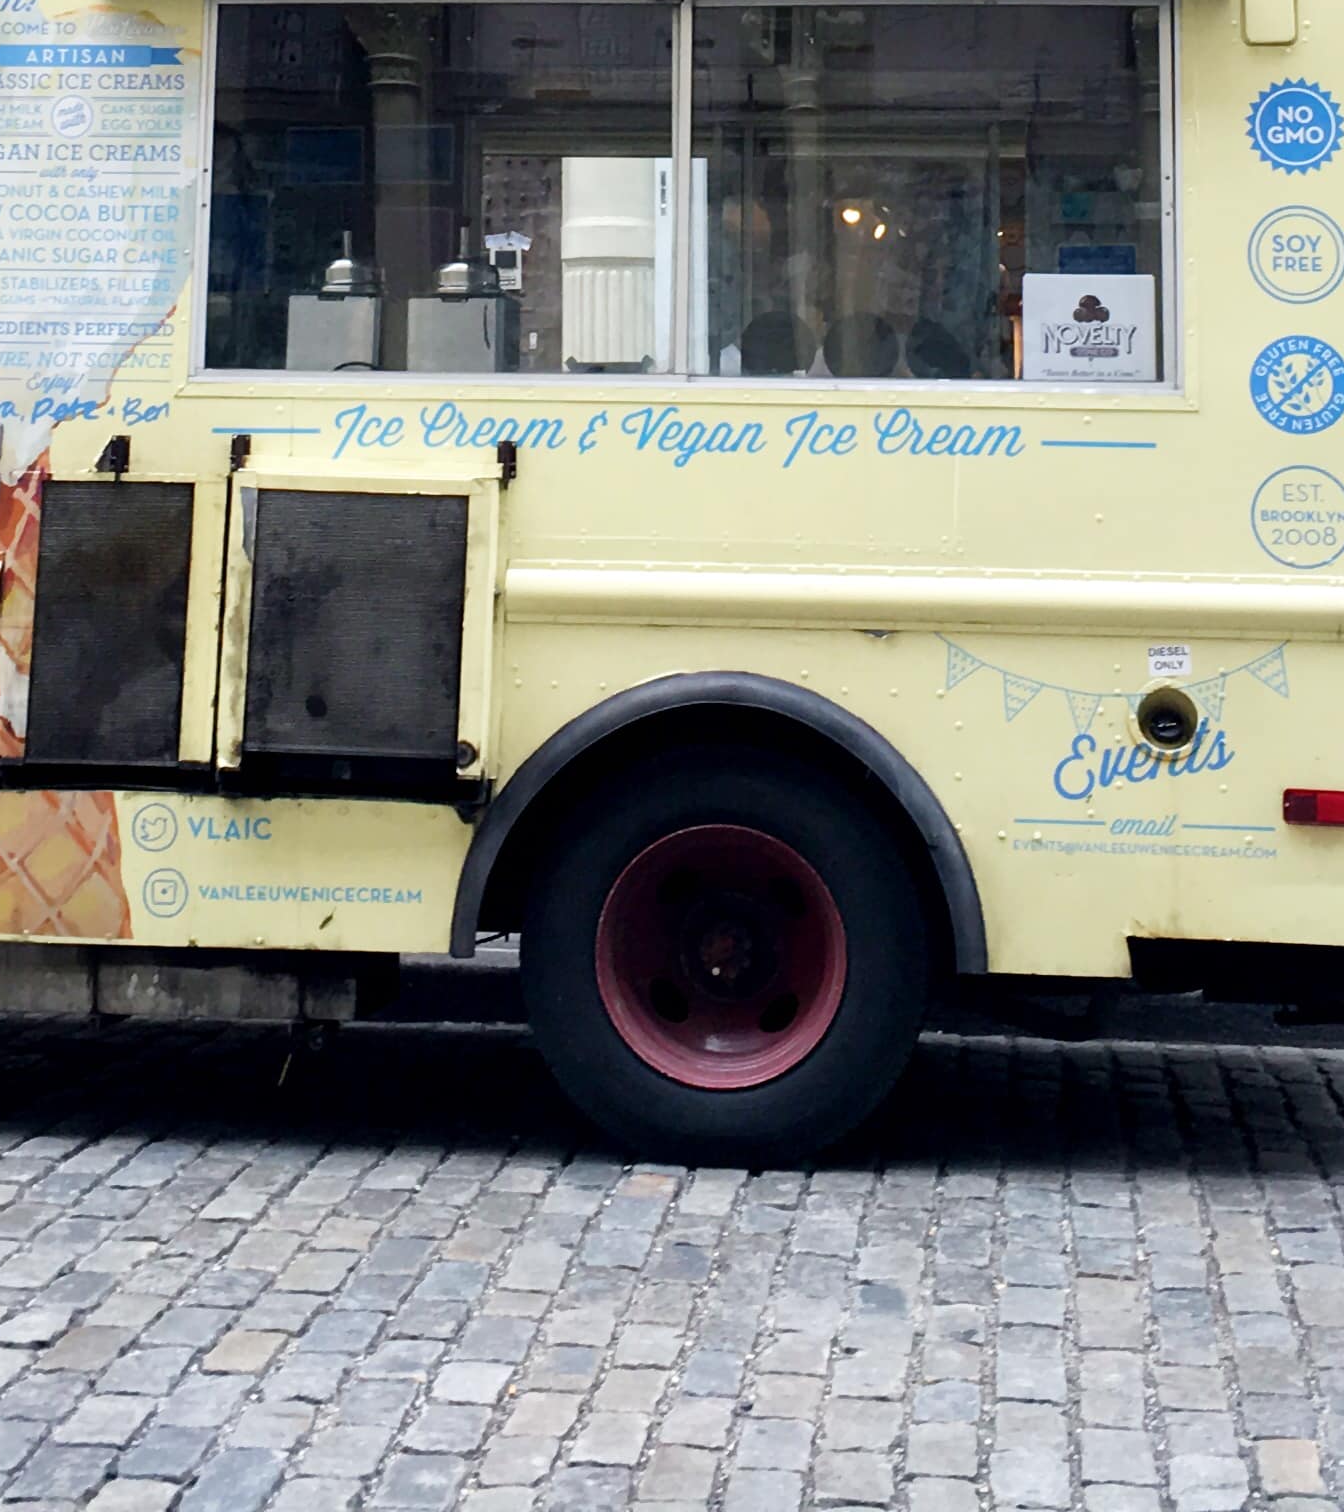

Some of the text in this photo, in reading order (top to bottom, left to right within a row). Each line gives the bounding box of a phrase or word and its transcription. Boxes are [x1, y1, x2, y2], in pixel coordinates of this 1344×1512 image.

[55, 22, 76, 35] TO
[26, 49, 126, 64] ARTISAN
[57, 74, 91, 90] ICE
[97, 74, 186, 90] CREAMS
[1276, 105, 1314, 124] NO
[101, 119, 132, 131] EGG
[1266, 126, 1325, 145] GMO
[46, 144, 83, 161] ICE
[89, 144, 181, 162] CREAMS
[64, 184, 137, 199] CASHEW
[141, 185, 180, 199] MILK
[9, 204, 91, 221] COCOA
[98, 204, 179, 222] BUTTER
[8, 228, 64, 241] VIRGIN
[67, 228, 147, 242] COCONUT
[1271, 234, 1322, 253] SOY
[52, 247, 118, 264] SUGAR
[123, 248, 177, 265] CANE
[1271, 256, 1323, 272] FREE
[74, 321, 175, 337] PERFECTED
[1040, 322, 1137, 354] NOVELTY
[37, 351, 80, 368] NOT
[84, 352, 173, 369] SCIENCE
[1255, 338, 1310, 377] GLUTEN
[25, 373, 84, 395] Enjoy!
[121, 396, 171, 427] Ben
[1255, 392, 1288, 427] FREE
[333, 402, 1027, 468] Ice Cream & Vegan Ice Cream
[1281, 483, 1325, 502] EST.
[1271, 527, 1337, 546] 2008
[1147, 646, 1189, 658] DIESEL
[1154, 658, 1184, 671] ONLY
[187, 816, 273, 841] VLAIC
[1109, 814, 1178, 838] email
[198, 884, 423, 904] VANLEEUWENICECREAM
